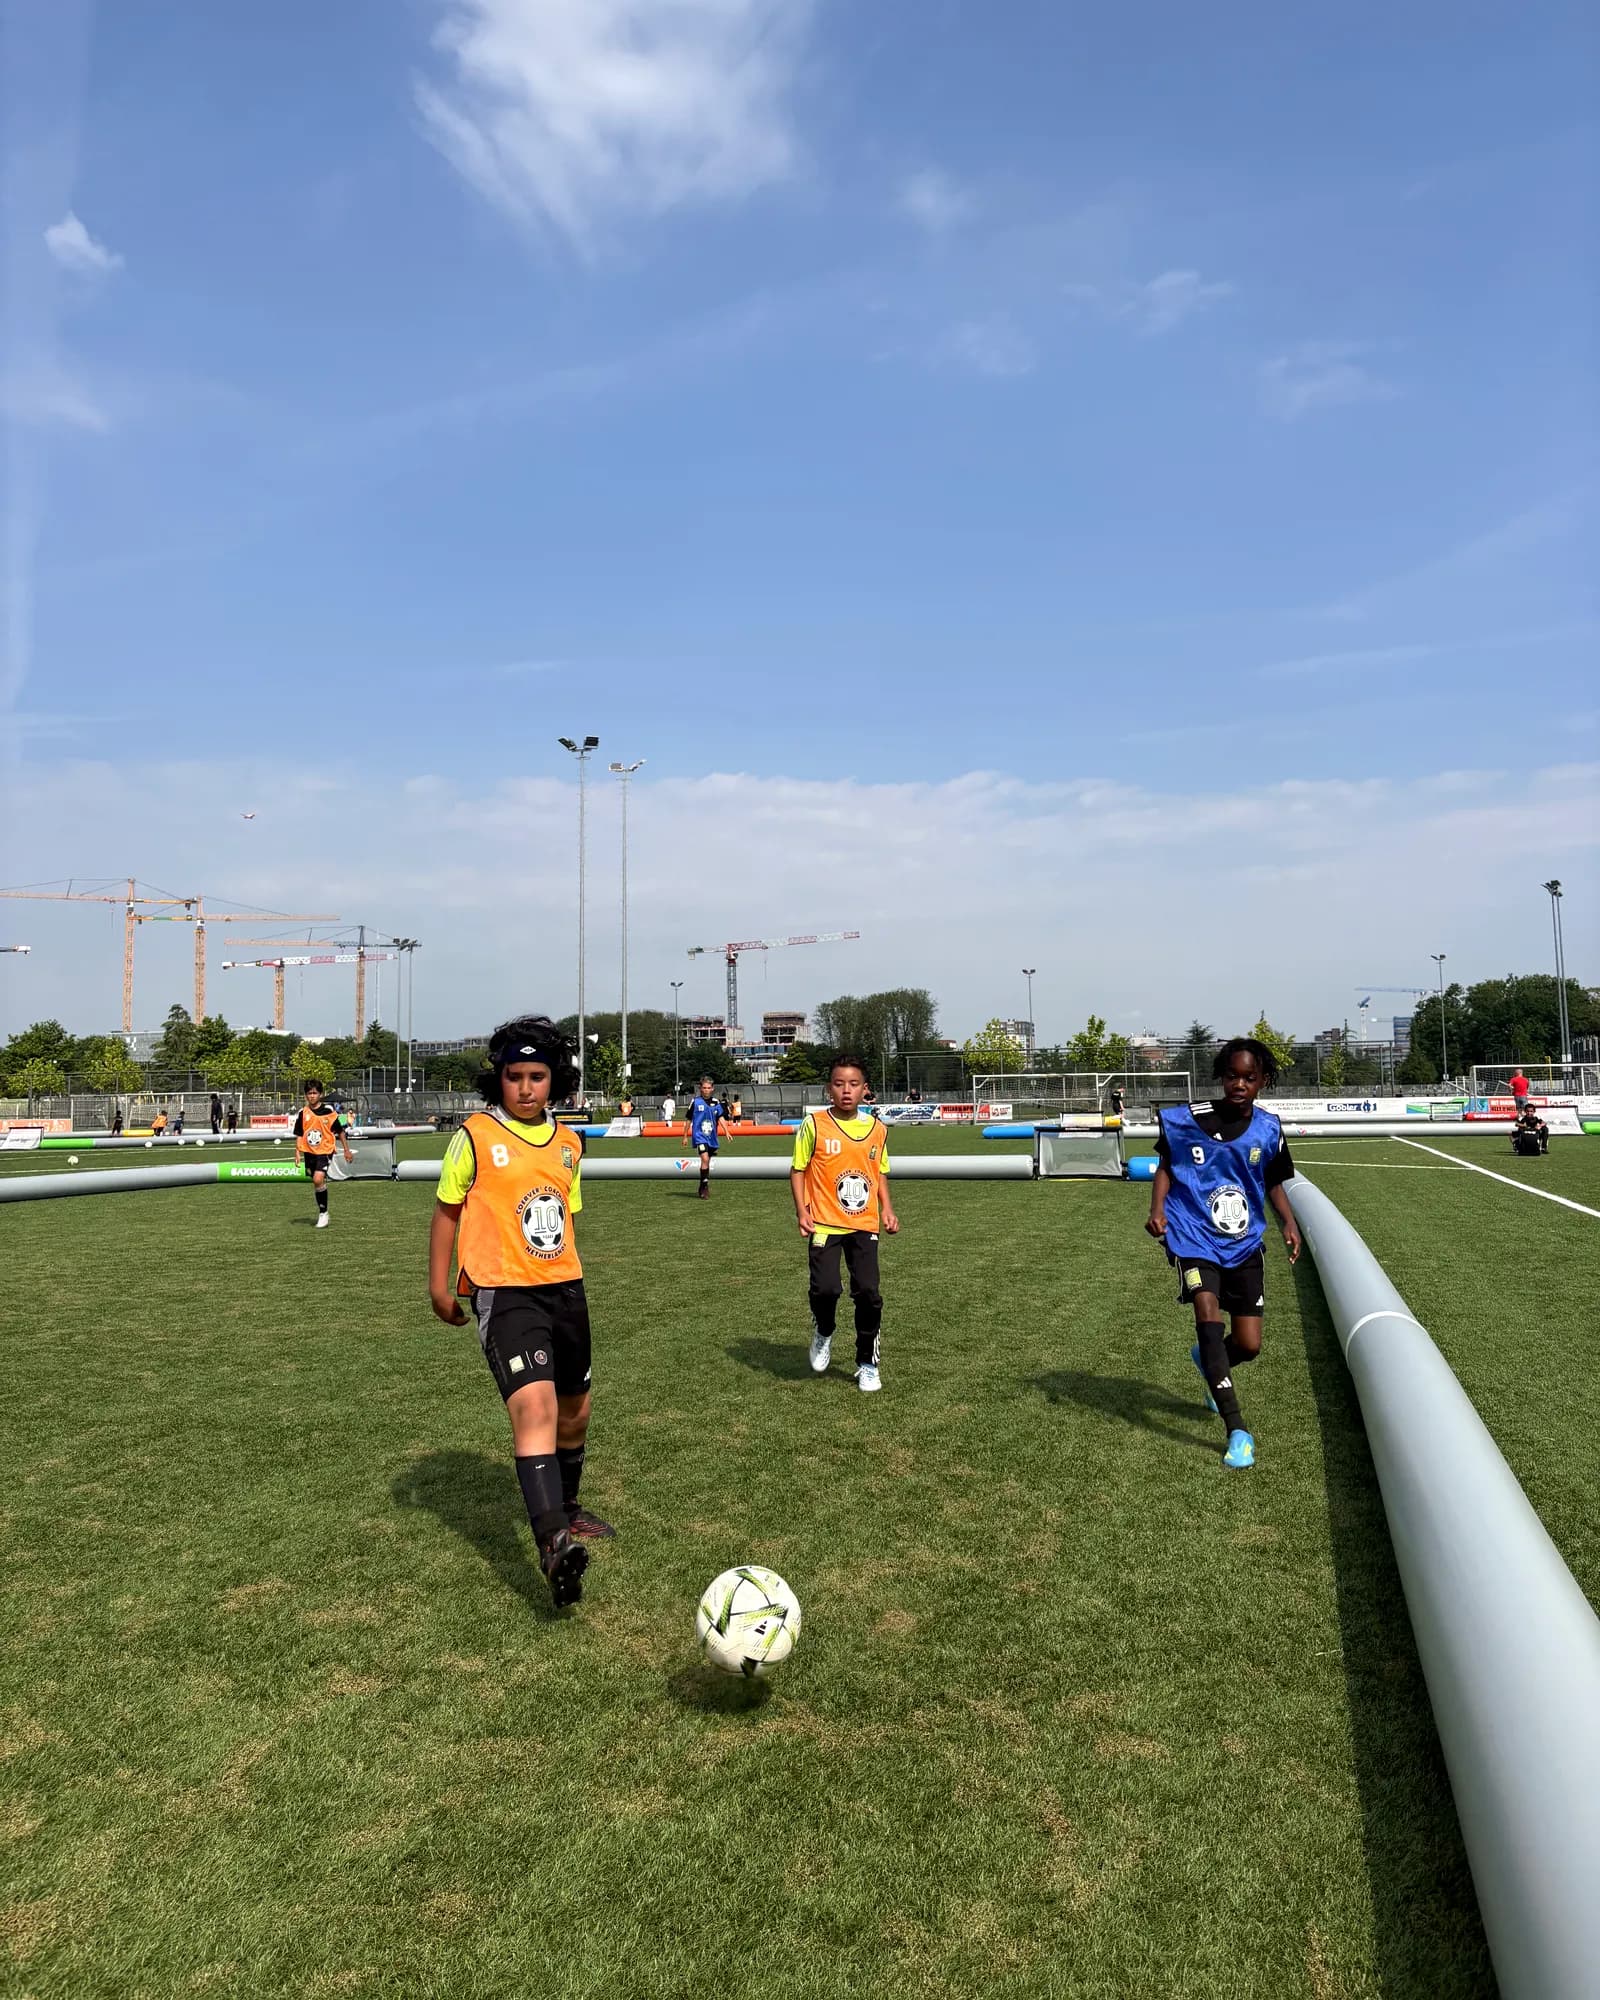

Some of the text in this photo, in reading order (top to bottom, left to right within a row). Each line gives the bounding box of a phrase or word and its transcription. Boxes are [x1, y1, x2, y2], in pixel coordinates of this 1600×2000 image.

[825, 1138, 841, 1154] 10
[1191, 1146, 1205, 1164] 9
[491, 1144, 509, 1168] 8
[231, 1167, 301, 1176] BAZOOKAGOAL
[844, 1181, 862, 1199] 10
[515, 1187, 539, 1215] COERVER
[1221, 1199, 1243, 1219] 10
[534, 1206, 558, 1232] 10
